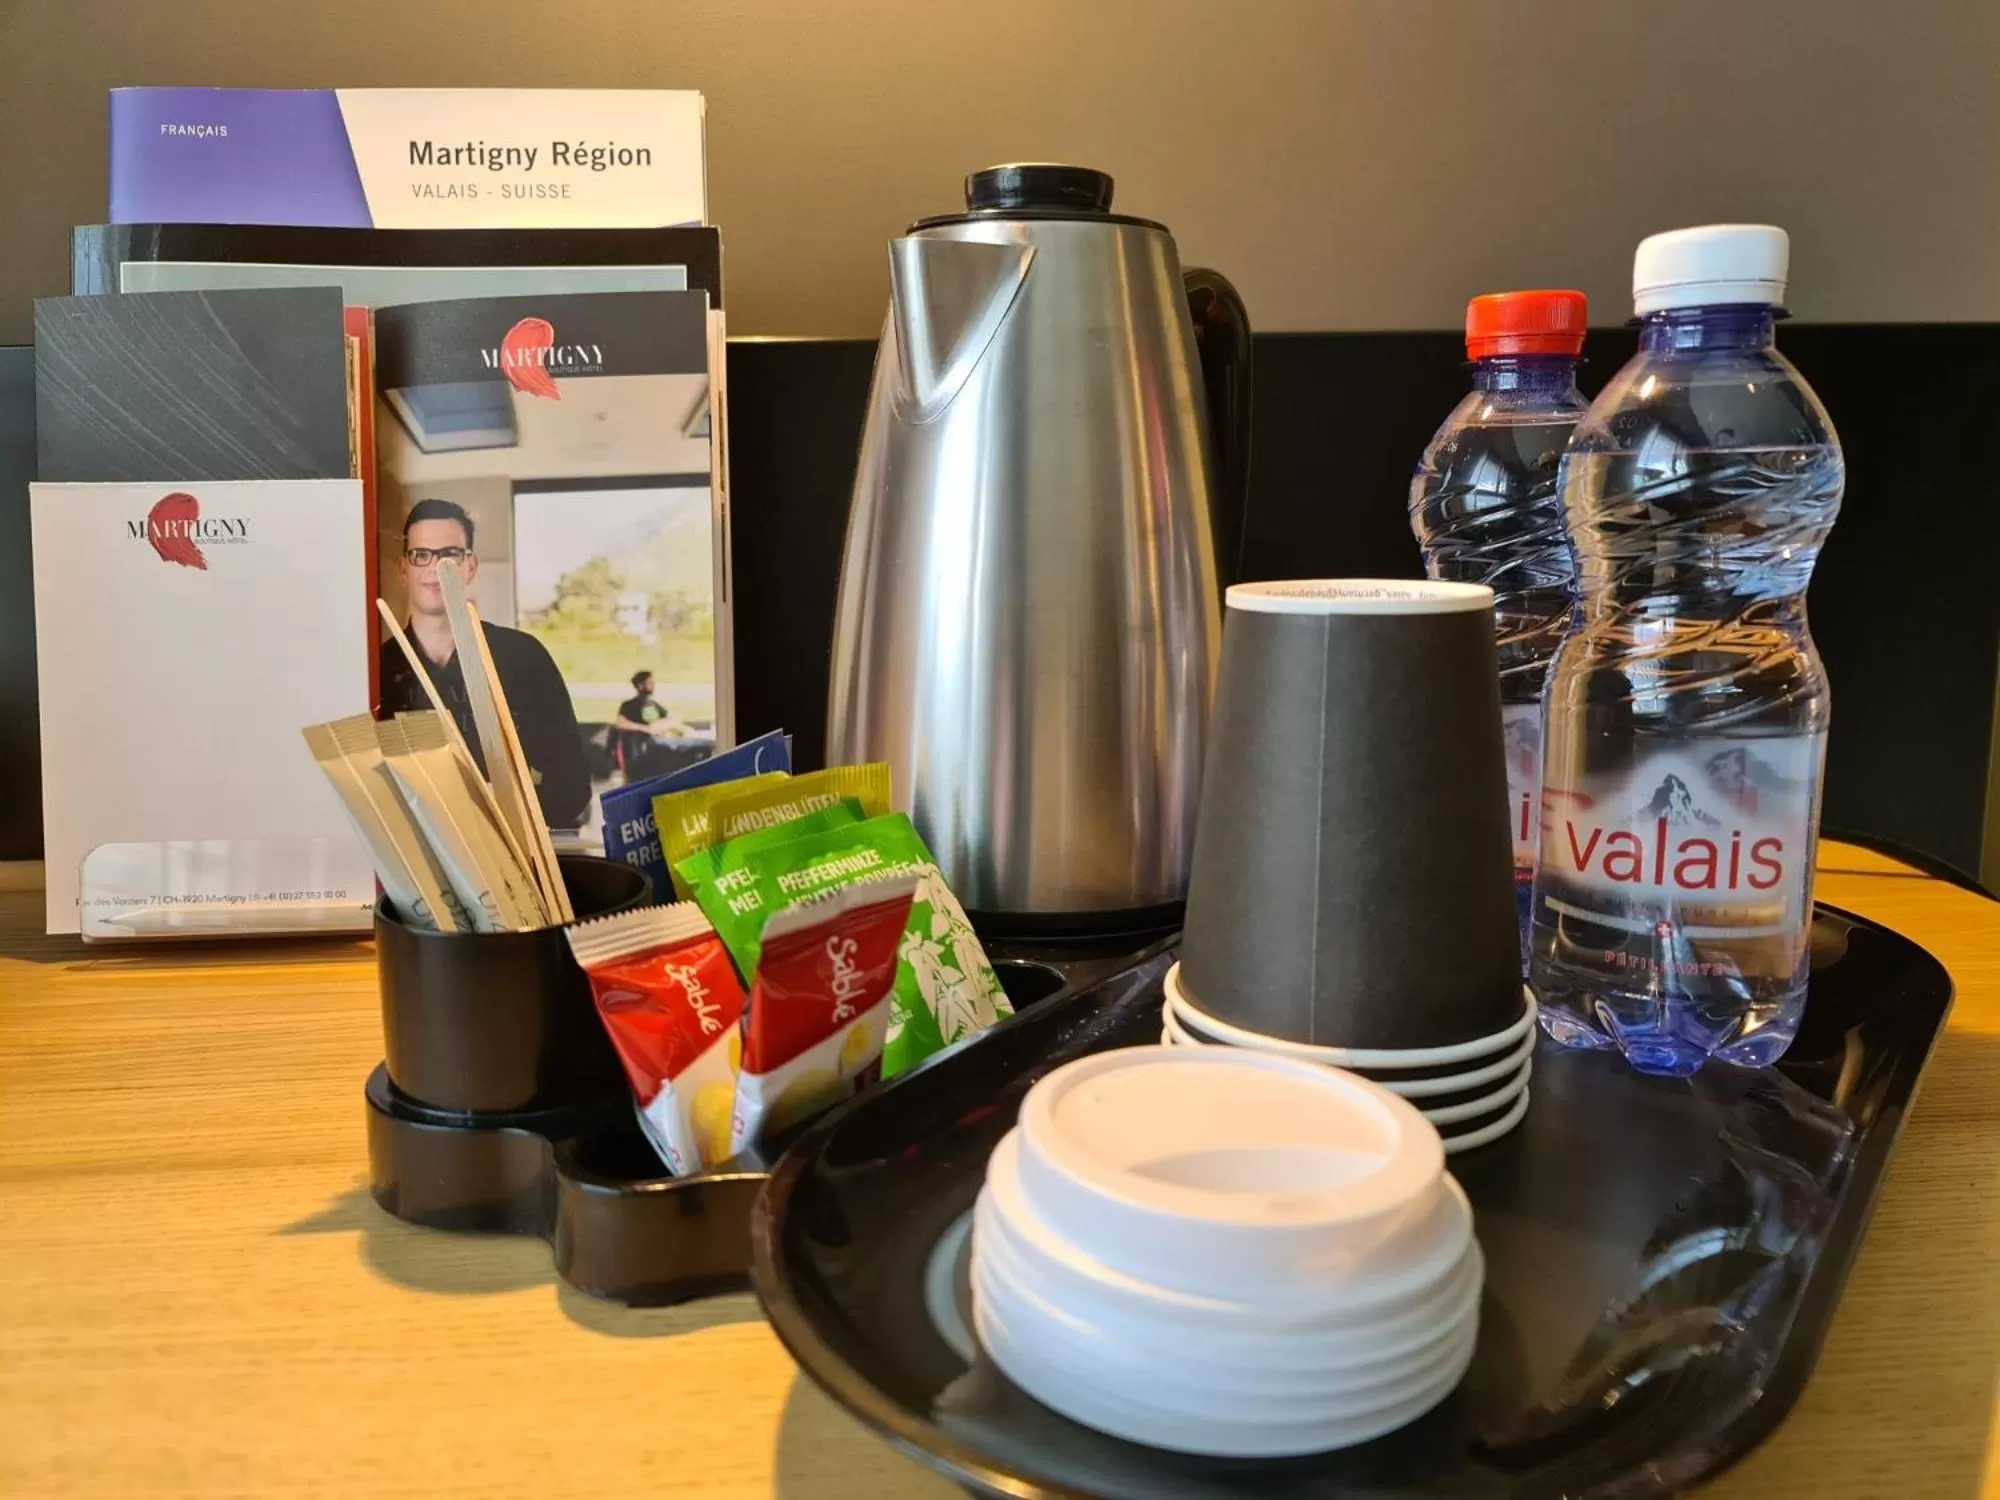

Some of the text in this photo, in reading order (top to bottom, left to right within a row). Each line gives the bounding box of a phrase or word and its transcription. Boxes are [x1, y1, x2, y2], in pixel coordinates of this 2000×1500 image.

[160, 123, 228, 138] FRANÇAIS
[408, 140, 652, 172] Martigny Région
[411, 183, 479, 199] VALAIS
[501, 183, 573, 199] SUISSE
[480, 343, 606, 369] MARTIGNY
[126, 518, 251, 539] MARTIGNY
[1566, 817, 1784, 890] valais
[777, 849, 883, 894] PFEFFERMINZE
[205, 892, 246, 905] Martigny
